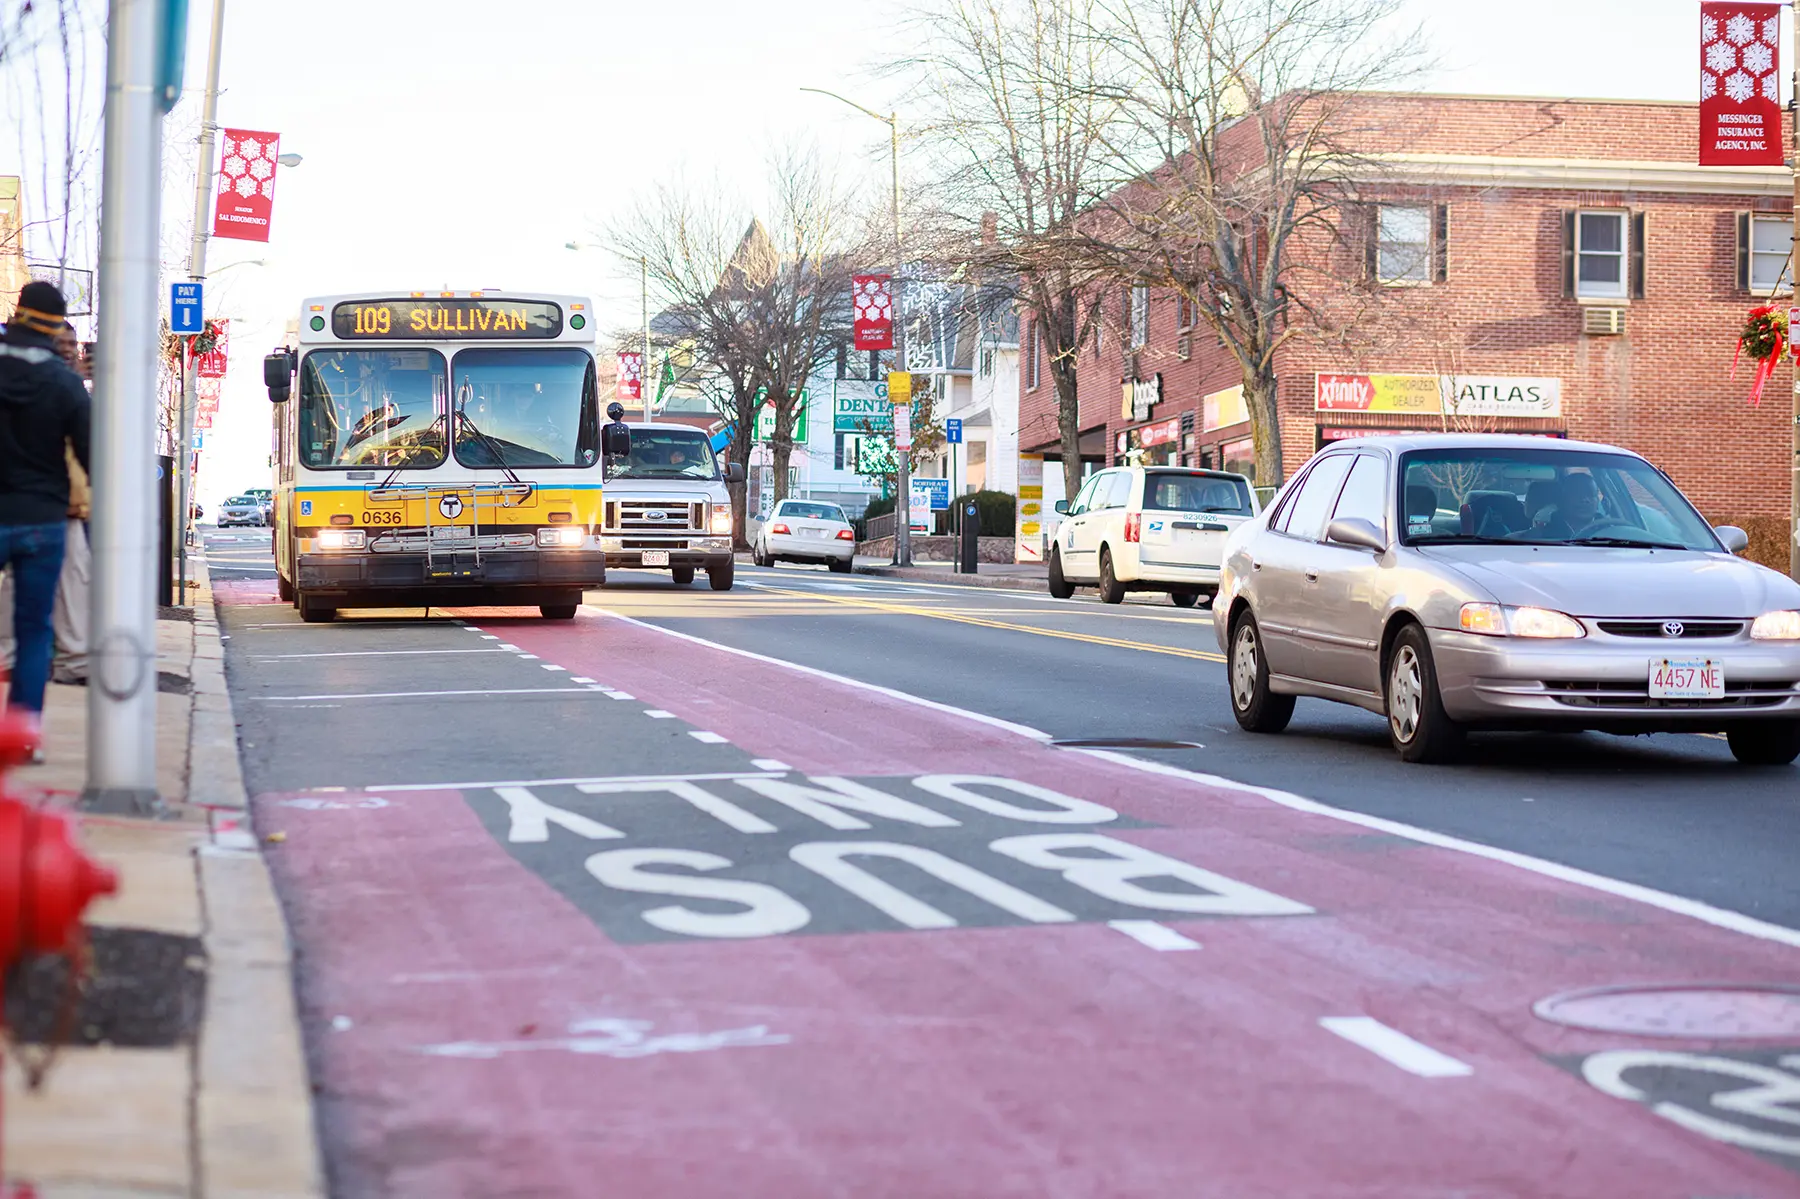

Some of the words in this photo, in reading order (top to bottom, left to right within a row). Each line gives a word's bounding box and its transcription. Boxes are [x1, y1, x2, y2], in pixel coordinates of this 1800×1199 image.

[1718, 114, 1763, 124] MESSINGER
[1718, 127, 1764, 137] INSURANCE
[1715, 140, 1749, 151] AGENCY,
[1750, 140, 1767, 150] INC.
[218, 213, 230, 221] SAL
[178, 286, 195, 296] PAY
[175, 297, 198, 305] HERE
[354, 307, 391, 334] 109
[410, 308, 528, 332] SULLIVAN
[1383, 379, 1435, 391] AUTHORIZED
[1319, 376, 1369, 408] xfinity
[1460, 384, 1541, 403] ATLAS
[840, 399, 896, 413] DENTA
[1393, 395, 1425, 407] DEALER
[361, 511, 402, 525] 0636
[1182, 512, 1218, 522] 8230926
[1654, 668, 1696, 689] 4457
[1700, 669, 1721, 689] NE
[492, 774, 1119, 843] ONLY
[584, 832, 1316, 939] BUS
